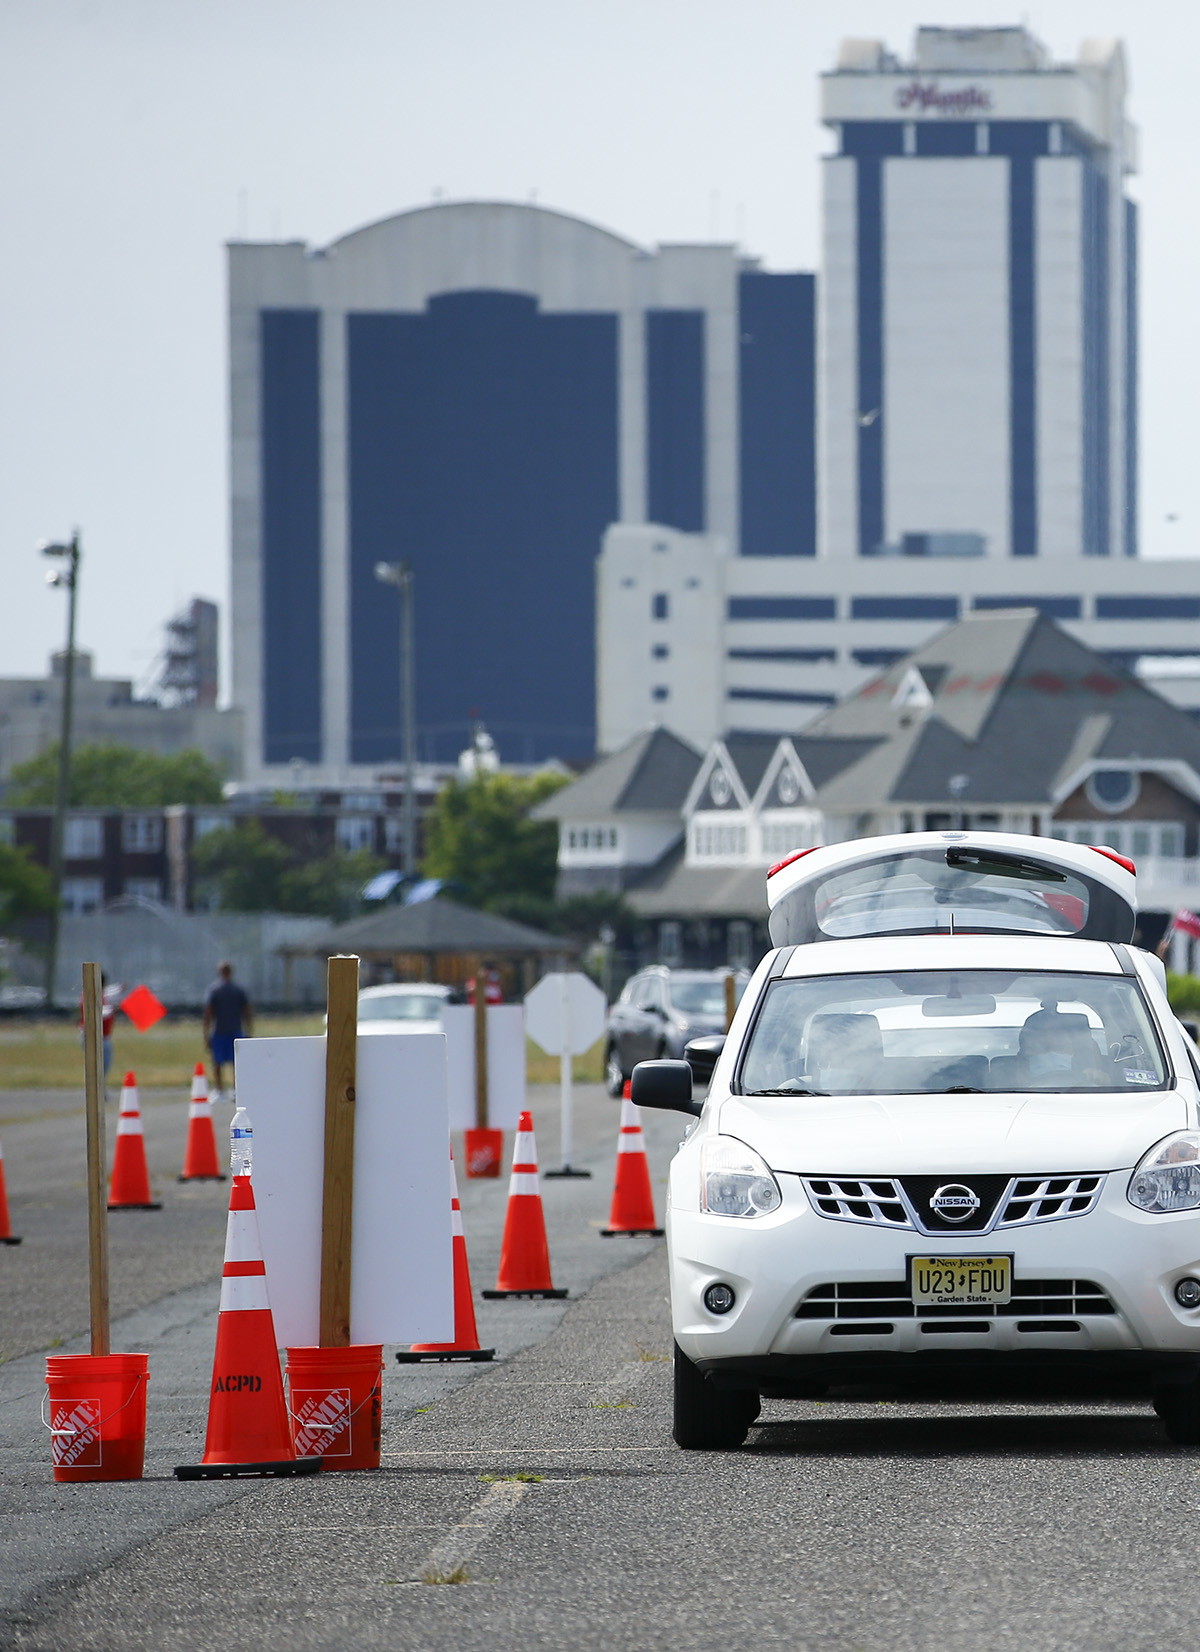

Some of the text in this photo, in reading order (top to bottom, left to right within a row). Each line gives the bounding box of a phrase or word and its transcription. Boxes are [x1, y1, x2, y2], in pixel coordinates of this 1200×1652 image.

[935, 1198, 975, 1206] NISSAN
[936, 1259, 986, 1269] New Jersey
[937, 1294, 987, 1304] Garden State
[214, 1375, 262, 1393] ACPD
[295, 1390, 350, 1455] HOME
[312, 1414, 350, 1455] DEPOT
[63, 1426, 100, 1466] DEPOT
